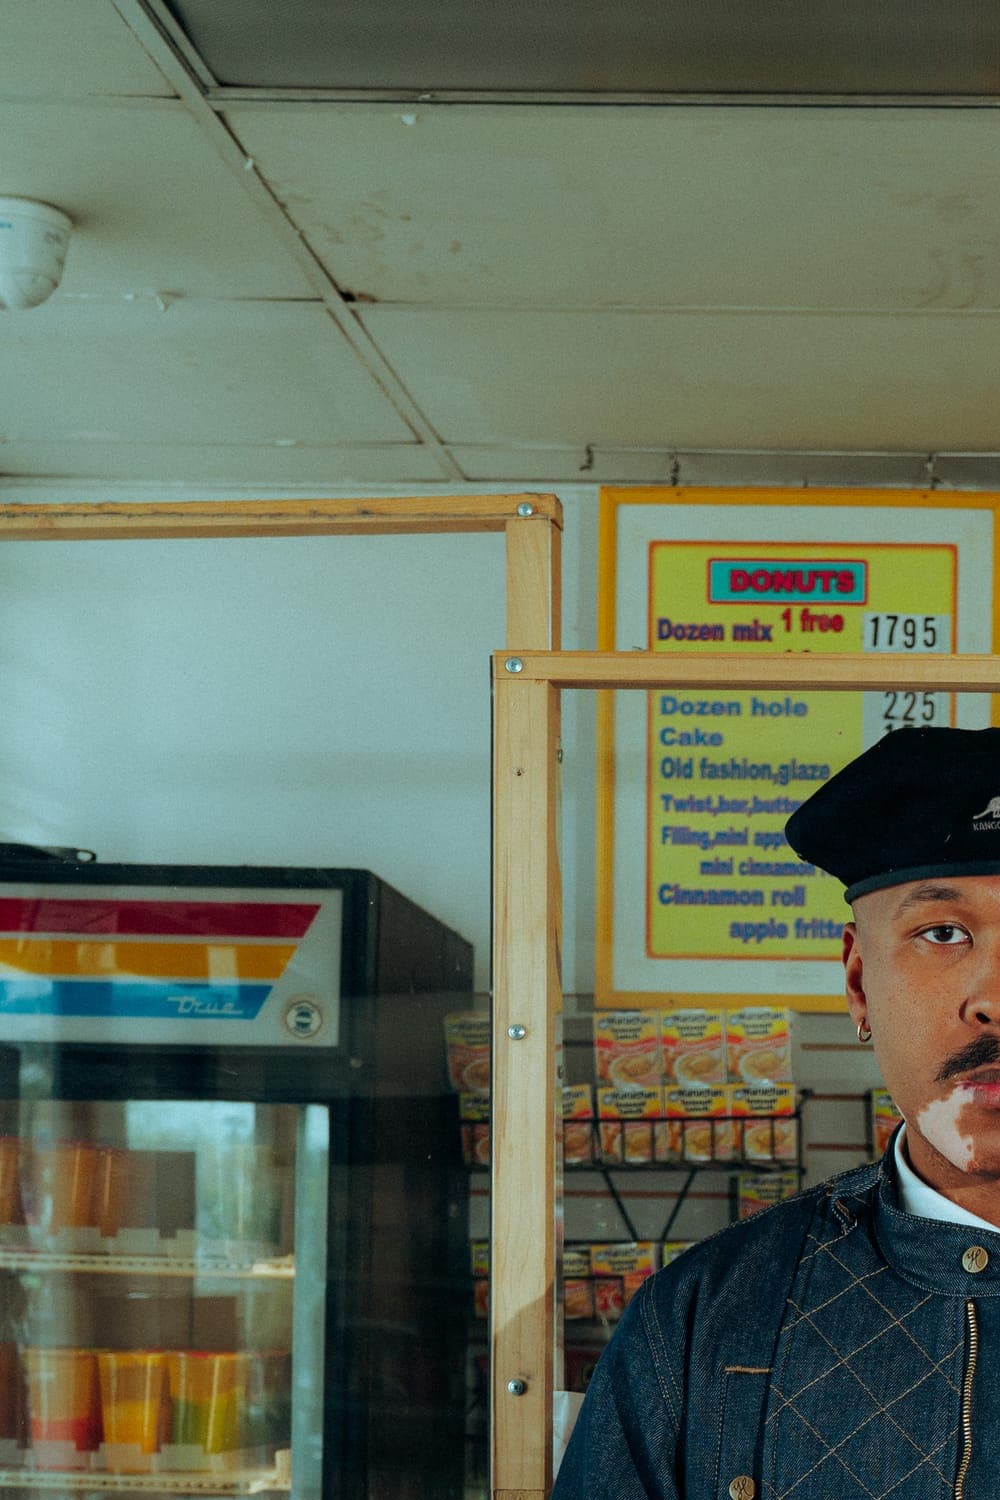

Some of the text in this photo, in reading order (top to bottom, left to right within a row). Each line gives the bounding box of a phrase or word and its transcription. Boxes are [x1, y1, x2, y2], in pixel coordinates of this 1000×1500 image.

[729, 570, 856, 593] DONUTS
[657, 618, 774, 642] Dozen mix
[800, 607, 844, 633] free
[870, 615, 937, 649] 1795
[660, 696, 809, 717] Dozen hole
[884, 691, 935, 721] 225
[659, 727, 723, 747] Cake
[661, 757, 694, 779] Old
[658, 884, 806, 907] Cinnamon roll
[729, 918, 788, 944] apple
